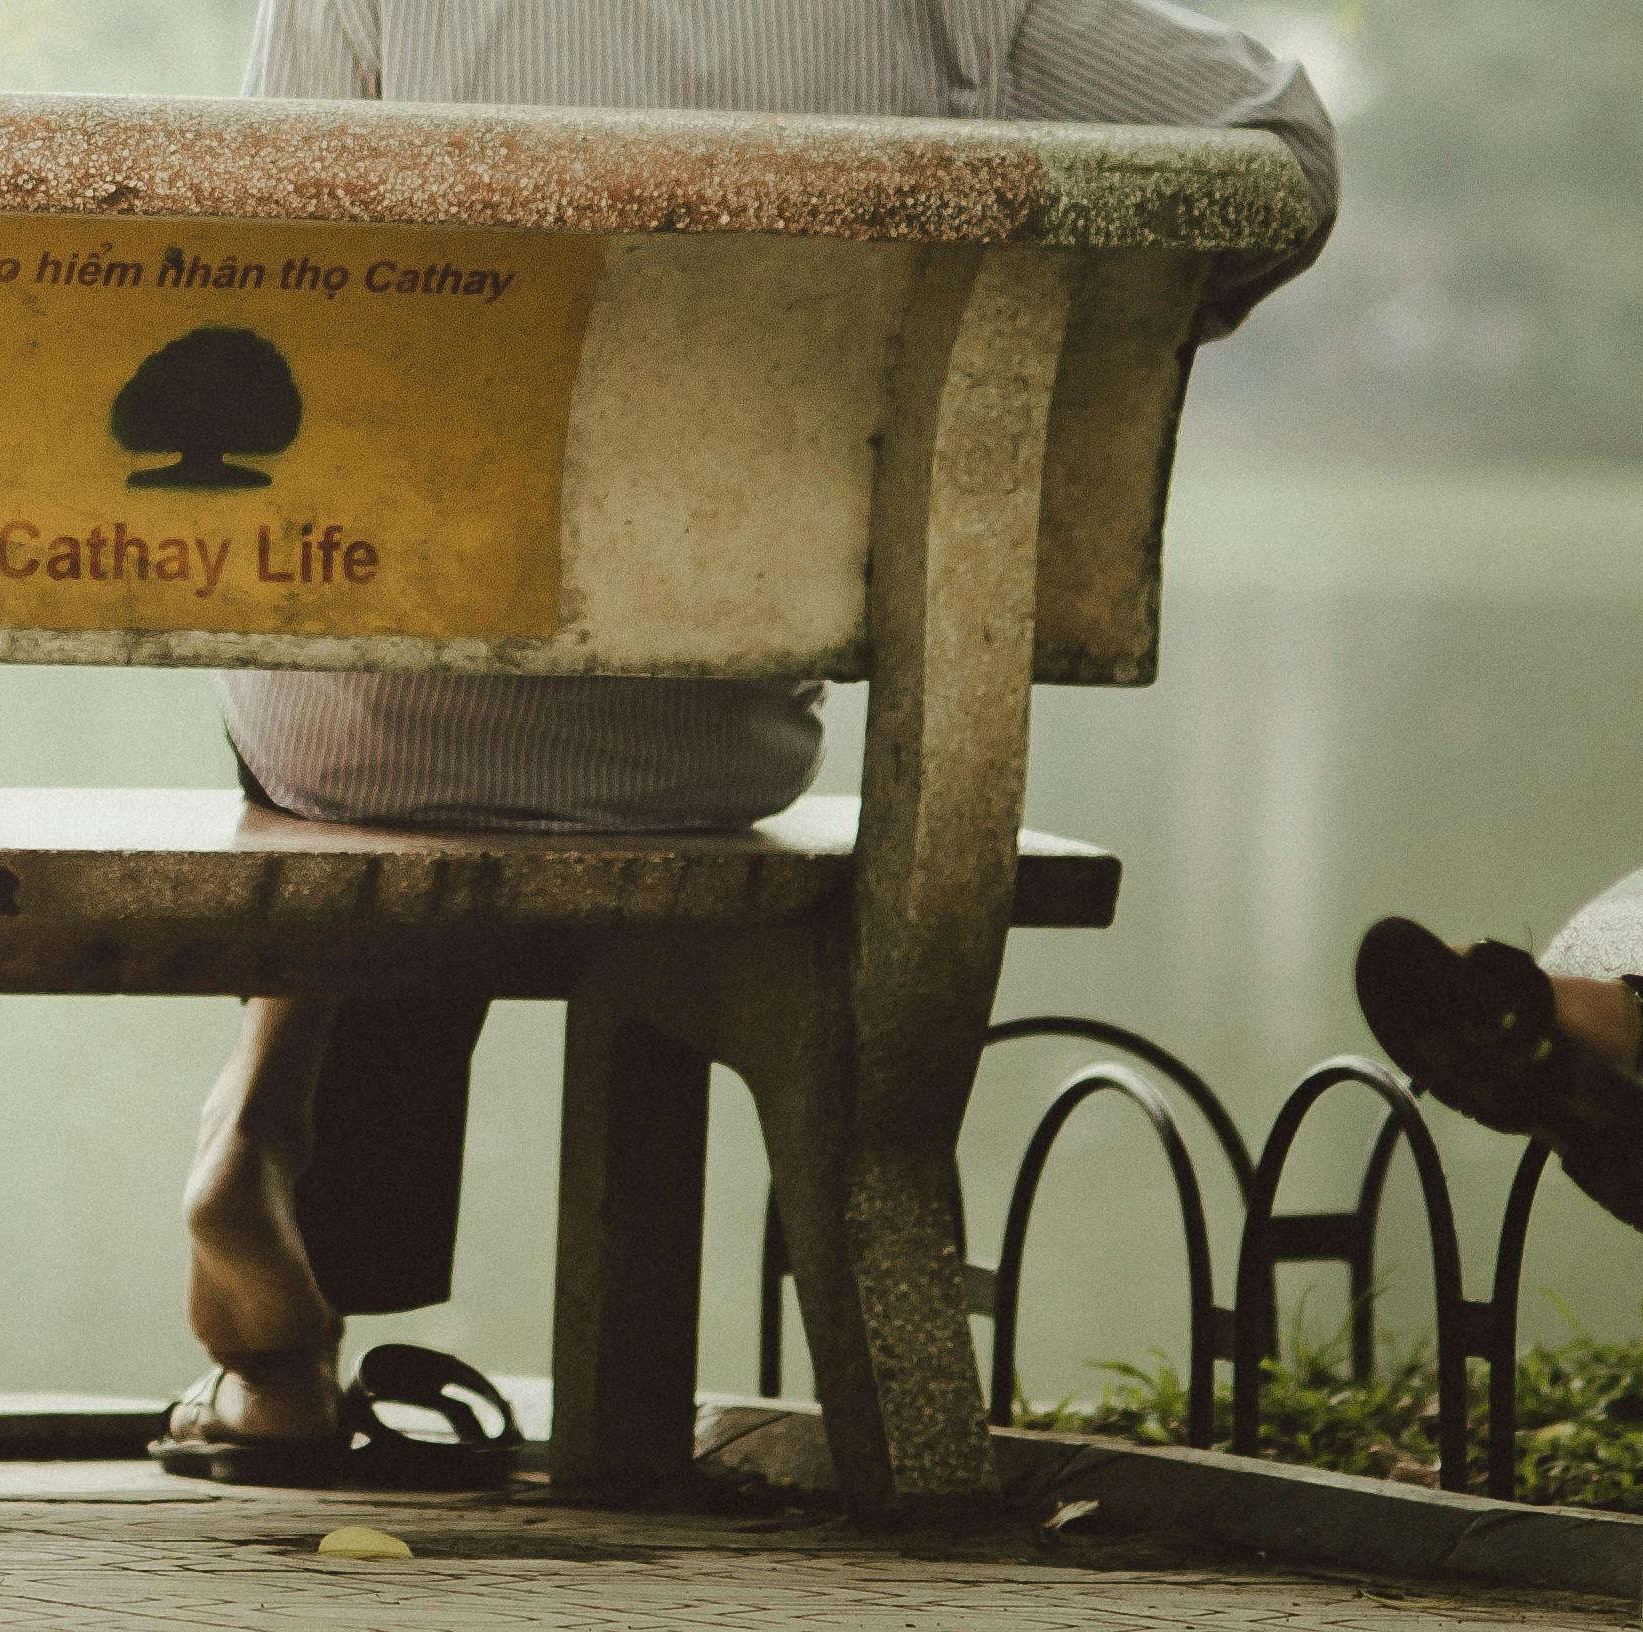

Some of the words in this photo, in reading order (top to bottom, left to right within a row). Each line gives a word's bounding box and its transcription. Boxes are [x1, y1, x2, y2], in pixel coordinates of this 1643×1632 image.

[35, 241, 142, 287] hiểm
[156, 254, 264, 290] nhân
[280, 257, 349, 299] thọ
[364, 260, 515, 304] Cathay
[257, 522, 380, 584] Life
